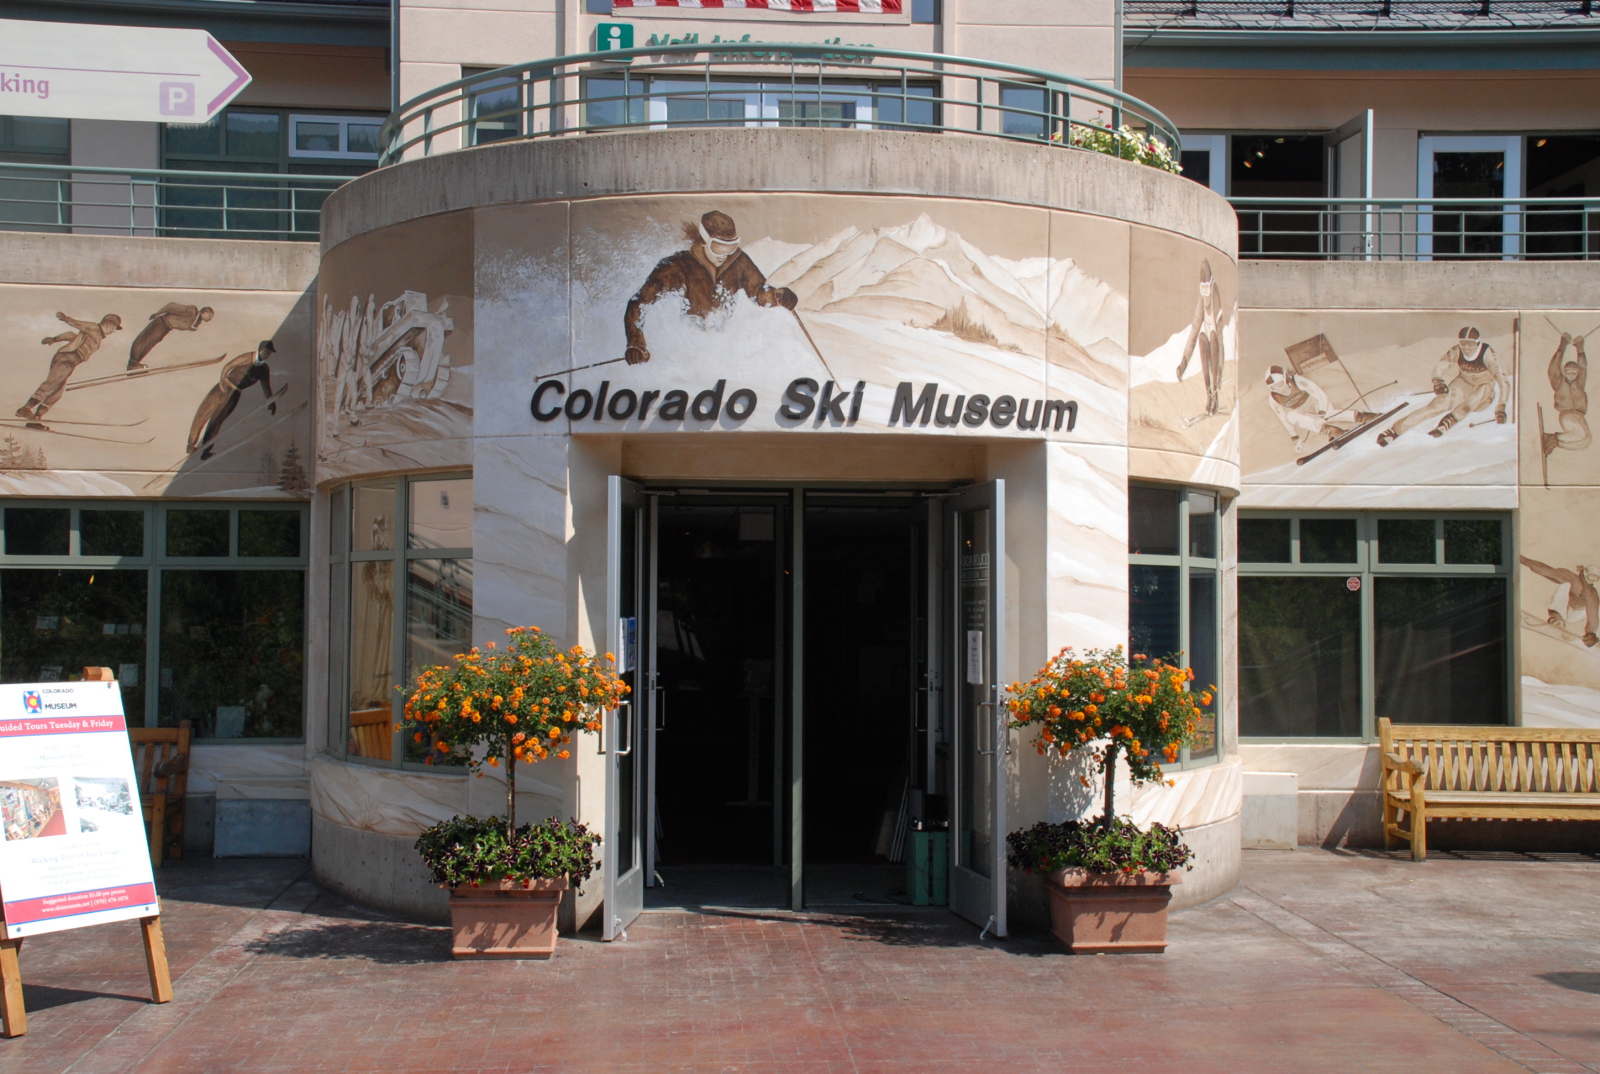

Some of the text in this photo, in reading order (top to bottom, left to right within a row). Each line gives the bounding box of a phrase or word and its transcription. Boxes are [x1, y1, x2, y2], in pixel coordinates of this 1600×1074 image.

[714, 34, 876, 59] Ifotio
[168, 87, 188, 110] P
[530, 378, 1079, 431] Colorado Ski Museum
[24, 722, 48, 730] Tours
[49, 720, 80, 730] Tuesday
[82, 719, 89, 728] &
[90, 718, 114, 728] Friday
